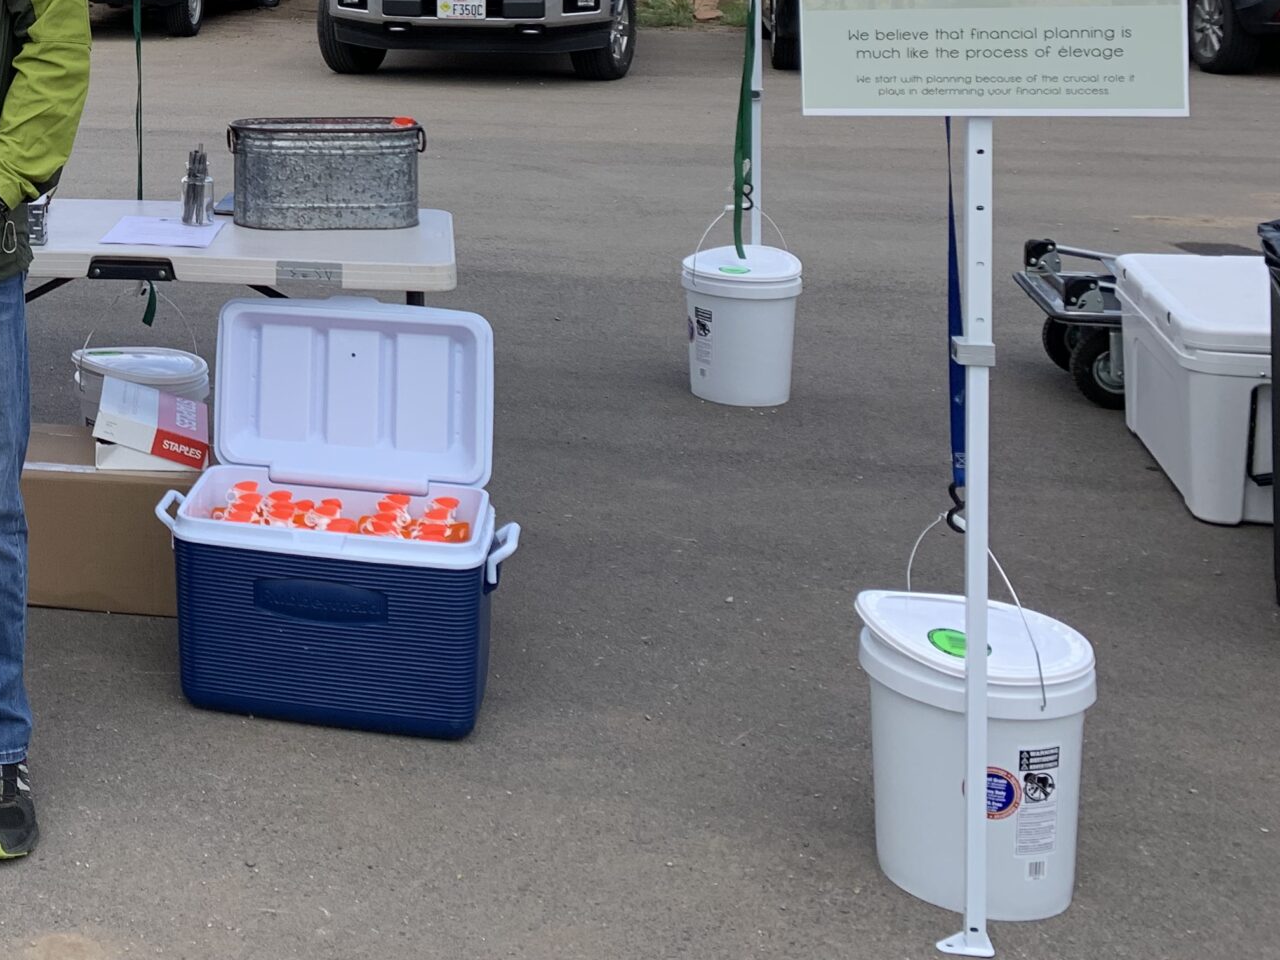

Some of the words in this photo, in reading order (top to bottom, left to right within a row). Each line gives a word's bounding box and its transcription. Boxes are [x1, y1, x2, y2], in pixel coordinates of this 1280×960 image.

[452, 3, 483, 16] F350C
[848, 30, 869, 41] We
[875, 29, 929, 41] believe
[935, 28, 964, 40] that
[970, 27, 1037, 40] financial
[1043, 26, 1115, 41] planning
[1122, 26, 1132, 38] is
[856, 47, 900, 59] much
[907, 47, 929, 59] like
[936, 47, 959, 59] the
[965, 47, 1027, 61] process
[1034, 46, 1052, 58] of
[1058, 45, 1124, 60] élevage
[856, 75, 870, 83] We
[875, 75, 897, 83] start
[900, 75, 923, 83] with
[926, 74, 971, 85] planning
[975, 74, 1022, 83] because
[1026, 74, 1038, 83] of
[1041, 74, 1058, 82] the
[1063, 74, 1098, 82] crucial
[1104, 74, 1125, 82] role
[1129, 74, 1134, 82] it
[878, 87, 905, 97] plays
[909, 87, 917, 95] in
[921, 86, 983, 97] determining
[988, 88, 1011, 97] your
[1016, 86, 1061, 95] financial
[162, 439, 202, 460] STAPLES
